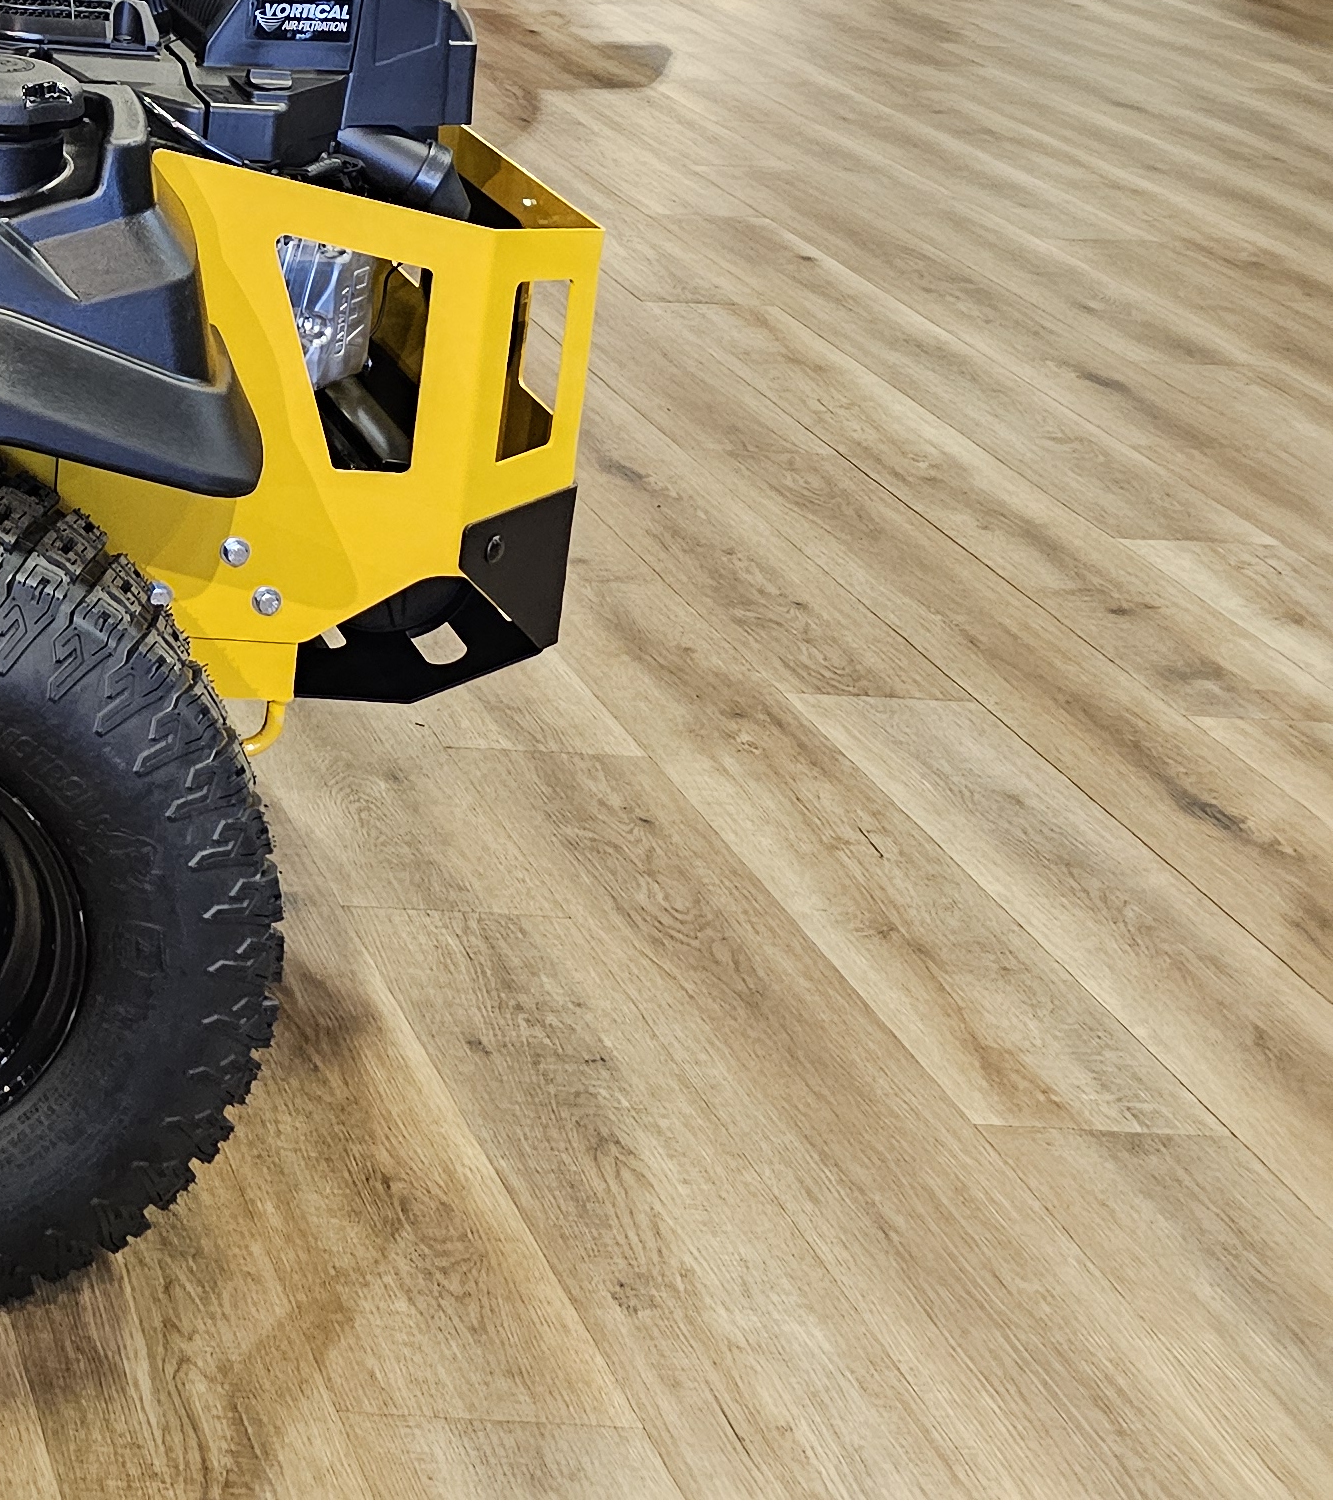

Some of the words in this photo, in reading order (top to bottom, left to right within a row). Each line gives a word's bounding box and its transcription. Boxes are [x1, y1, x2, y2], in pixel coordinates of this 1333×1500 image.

[264, 3, 350, 20] VORTICAL
[281, 20, 298, 31] AIR
[298, 20, 348, 33] FILTRATION
